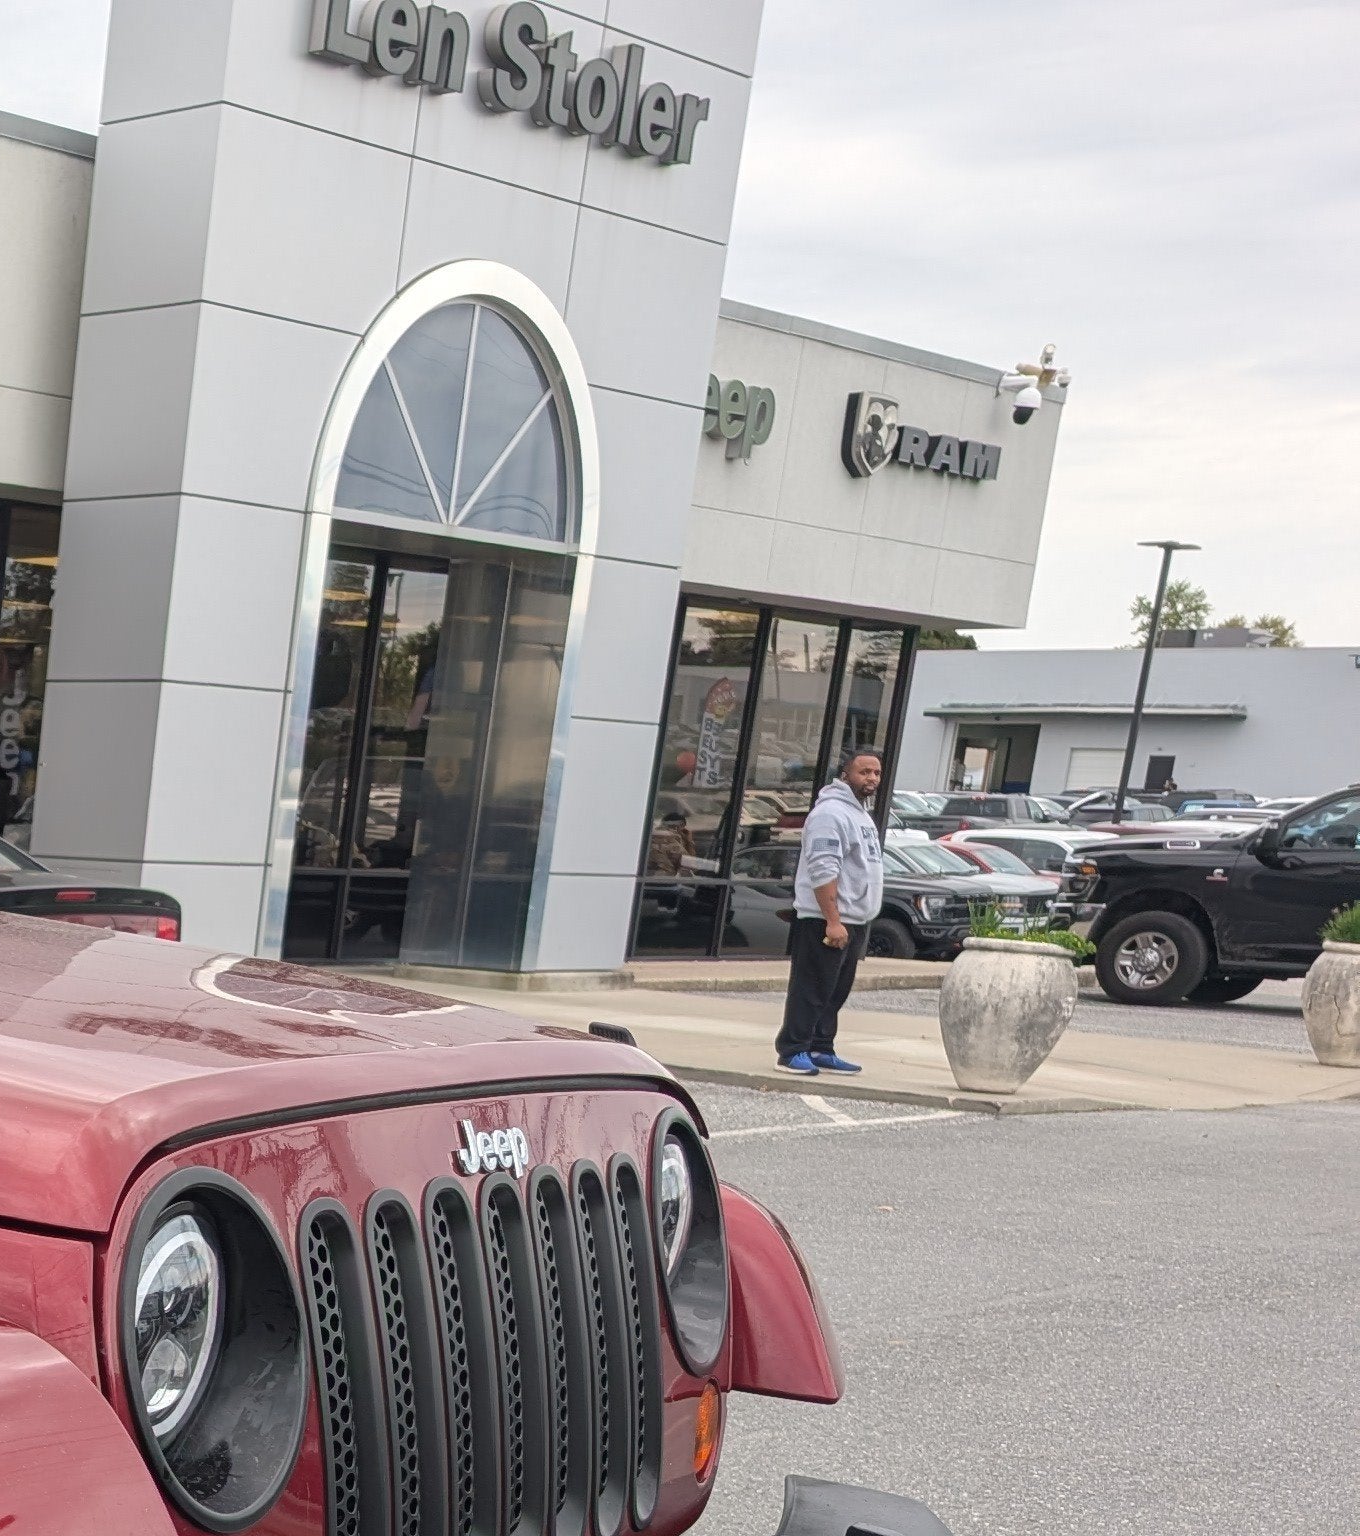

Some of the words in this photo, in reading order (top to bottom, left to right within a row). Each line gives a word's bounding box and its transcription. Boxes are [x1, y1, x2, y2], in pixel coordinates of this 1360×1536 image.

[309, 0, 471, 95] Len
[478, 0, 710, 166] Stoler
[895, 424, 1002, 481] RAM
[457, 1119, 529, 1179] Jeep
